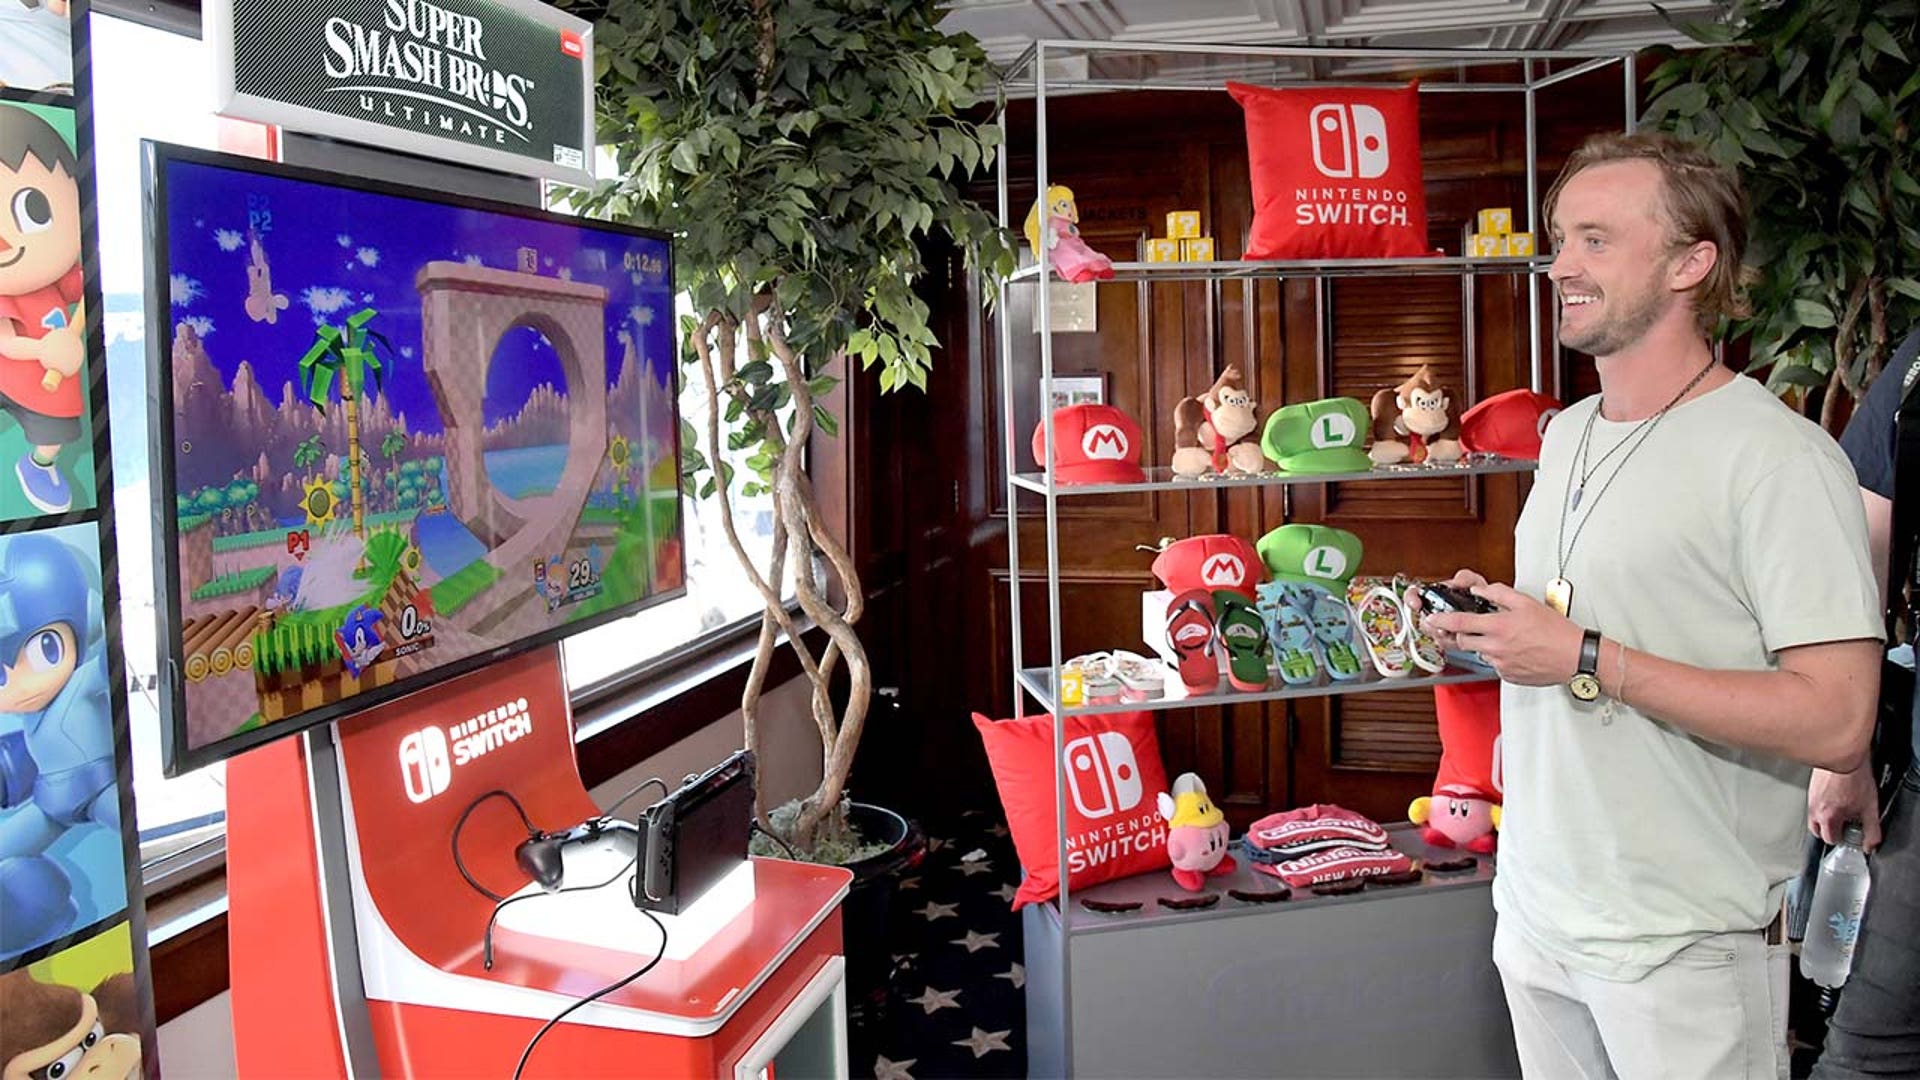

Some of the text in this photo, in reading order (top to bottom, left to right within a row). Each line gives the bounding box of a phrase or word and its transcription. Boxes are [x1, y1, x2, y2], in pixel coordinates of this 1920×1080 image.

[384, 0, 486, 60] SUPER
[323, 17, 443, 89] SMASH
[360, 94, 506, 144] ULTIMATE
[1296, 188, 1407, 203] NINTENDO
[250, 210, 272, 230] P2
[1296, 203, 1407, 226] SWITCH
[1088, 429, 1124, 453] M
[1323, 418, 1344, 442] L
[288, 530, 309, 554] P1
[1206, 558, 1240, 581] M
[1315, 550, 1334, 573] L
[395, 642, 420, 657] SONIC
[449, 697, 529, 741] NINTENDO
[453, 711, 533, 766] SWITCH
[1065, 811, 1162, 850] NINTENDO
[1068, 825, 1166, 873] SWITCH
[1312, 870, 1346, 885] NEW
